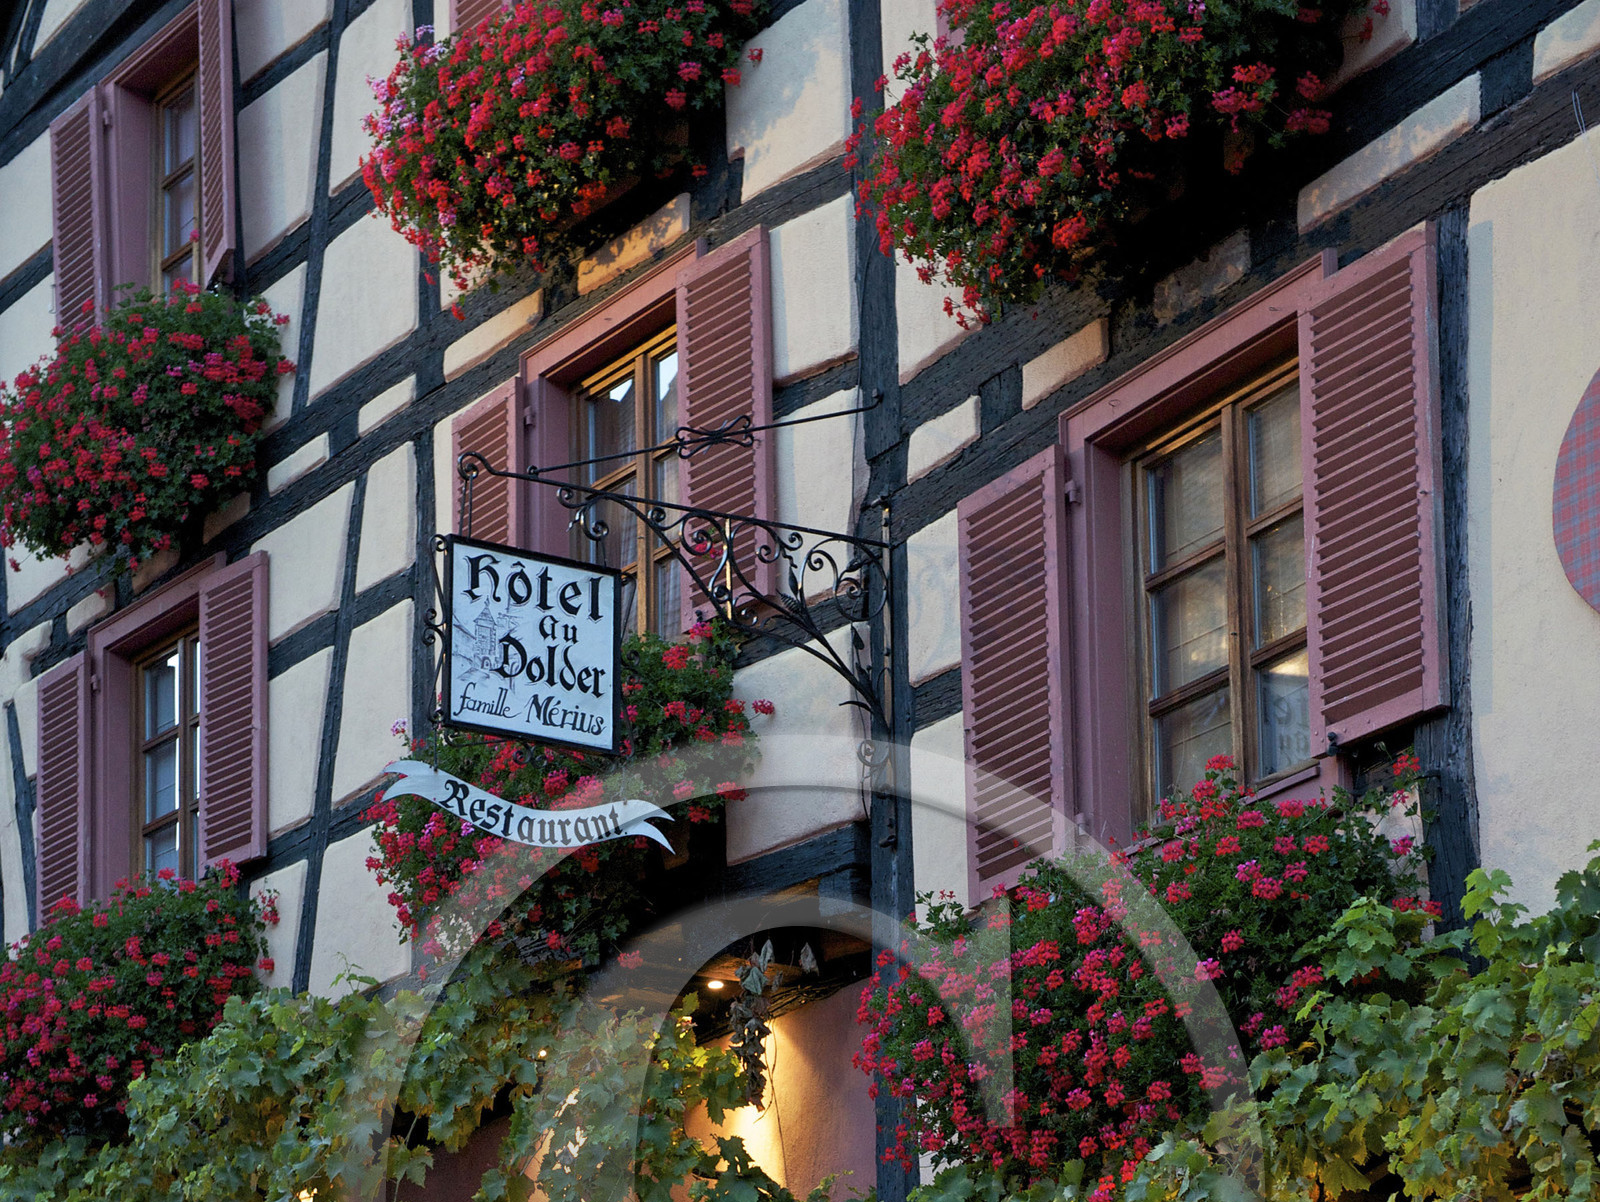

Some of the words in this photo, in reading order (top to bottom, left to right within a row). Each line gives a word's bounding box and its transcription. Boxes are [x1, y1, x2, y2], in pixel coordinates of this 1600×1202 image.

[539, 614, 579, 645] au
[491, 634, 607, 699] Dolder
[454, 683, 523, 719] famille
[526, 693, 608, 737] Mérius
[440, 778, 628, 845] Restaurant
